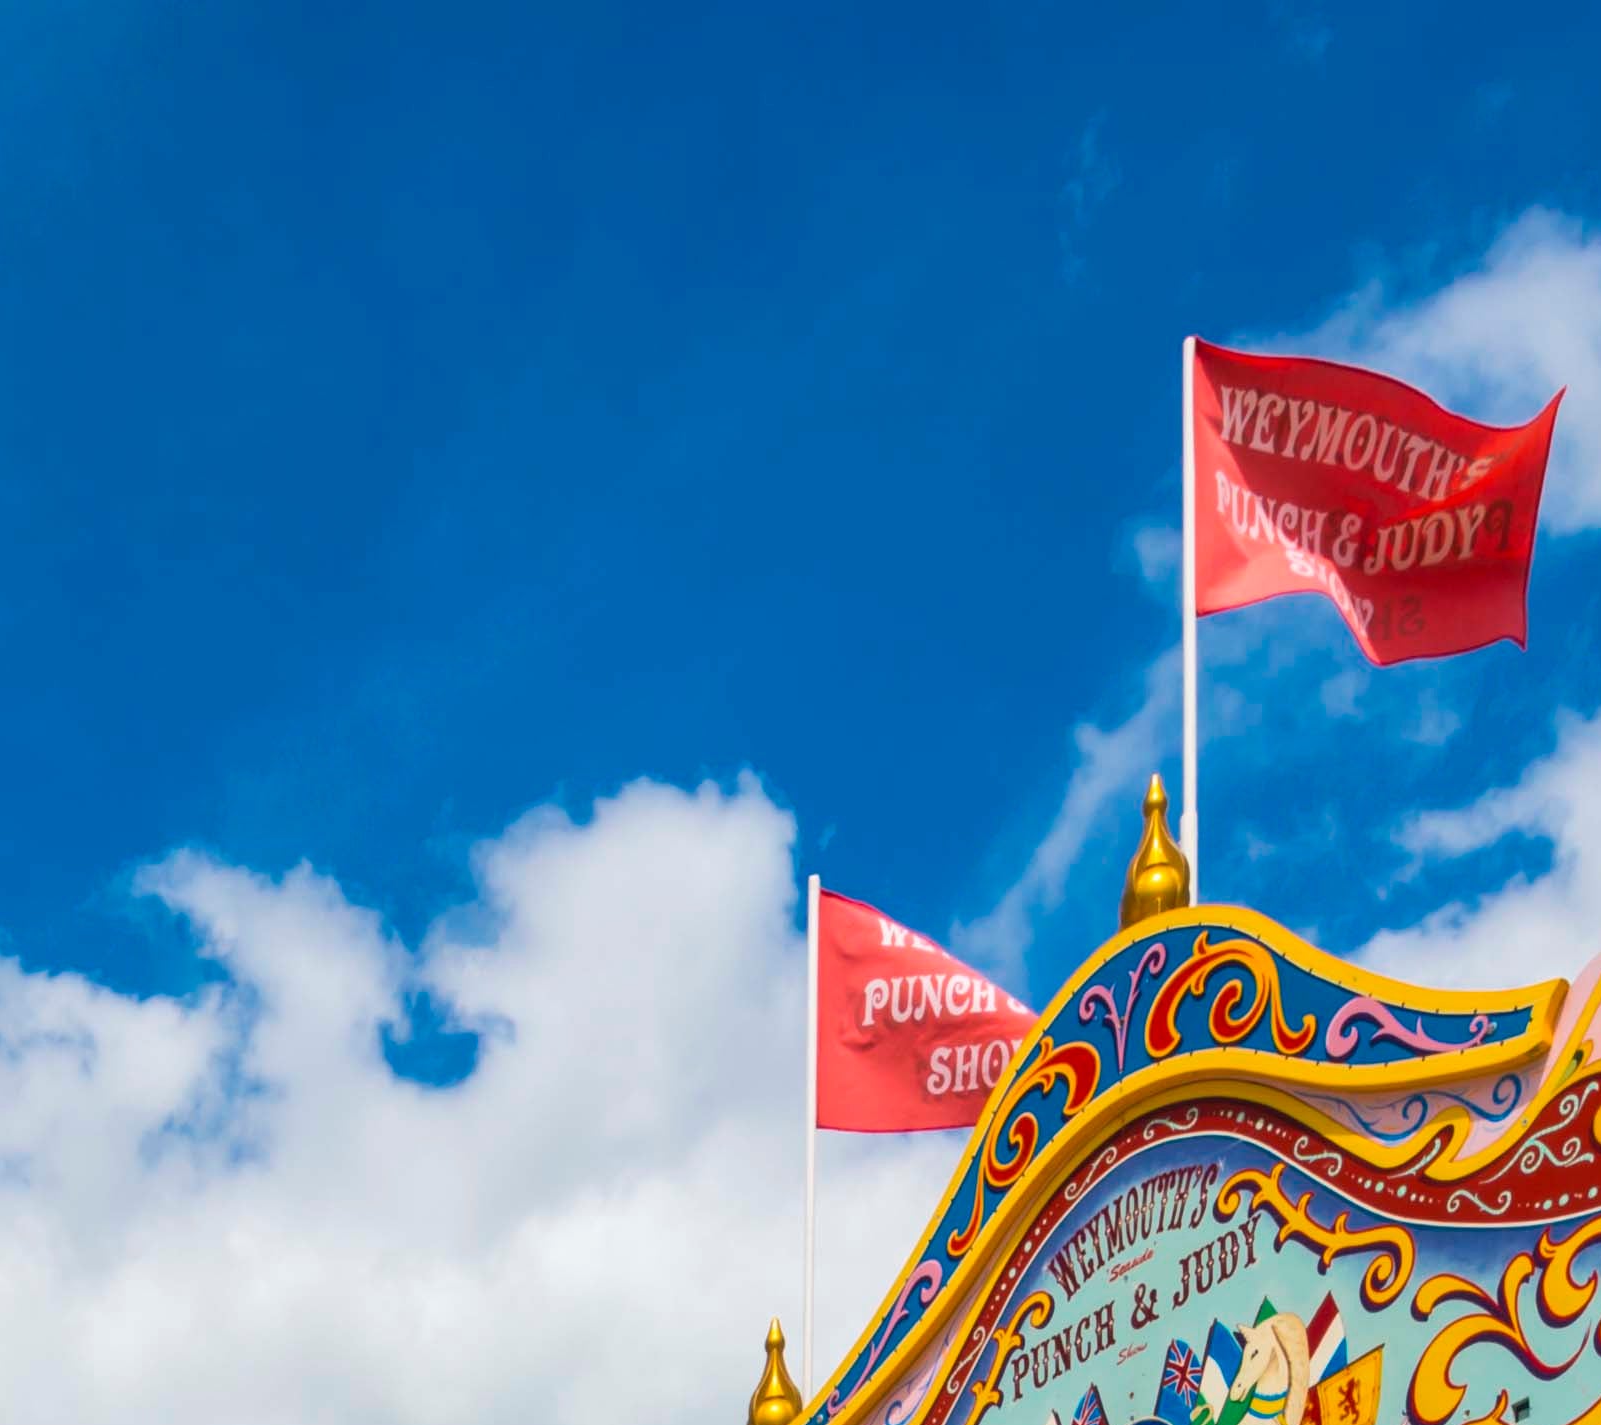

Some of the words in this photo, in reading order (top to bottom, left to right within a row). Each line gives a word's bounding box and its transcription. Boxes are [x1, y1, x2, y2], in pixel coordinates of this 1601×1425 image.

[1219, 385, 1496, 502] WEYMOUTH'S
[1214, 470, 1329, 552] PUNCH
[1332, 513, 1363, 568] &
[1363, 503, 1487, 575] JUDY
[926, 1038, 1024, 1096] SHO
[1048, 1162, 1220, 1302] WEYMOUTH'S
[1010, 1300, 1117, 1400] PUNCH
[1130, 1282, 1160, 1330] &
[1172, 1212, 1262, 1311] JUDY
